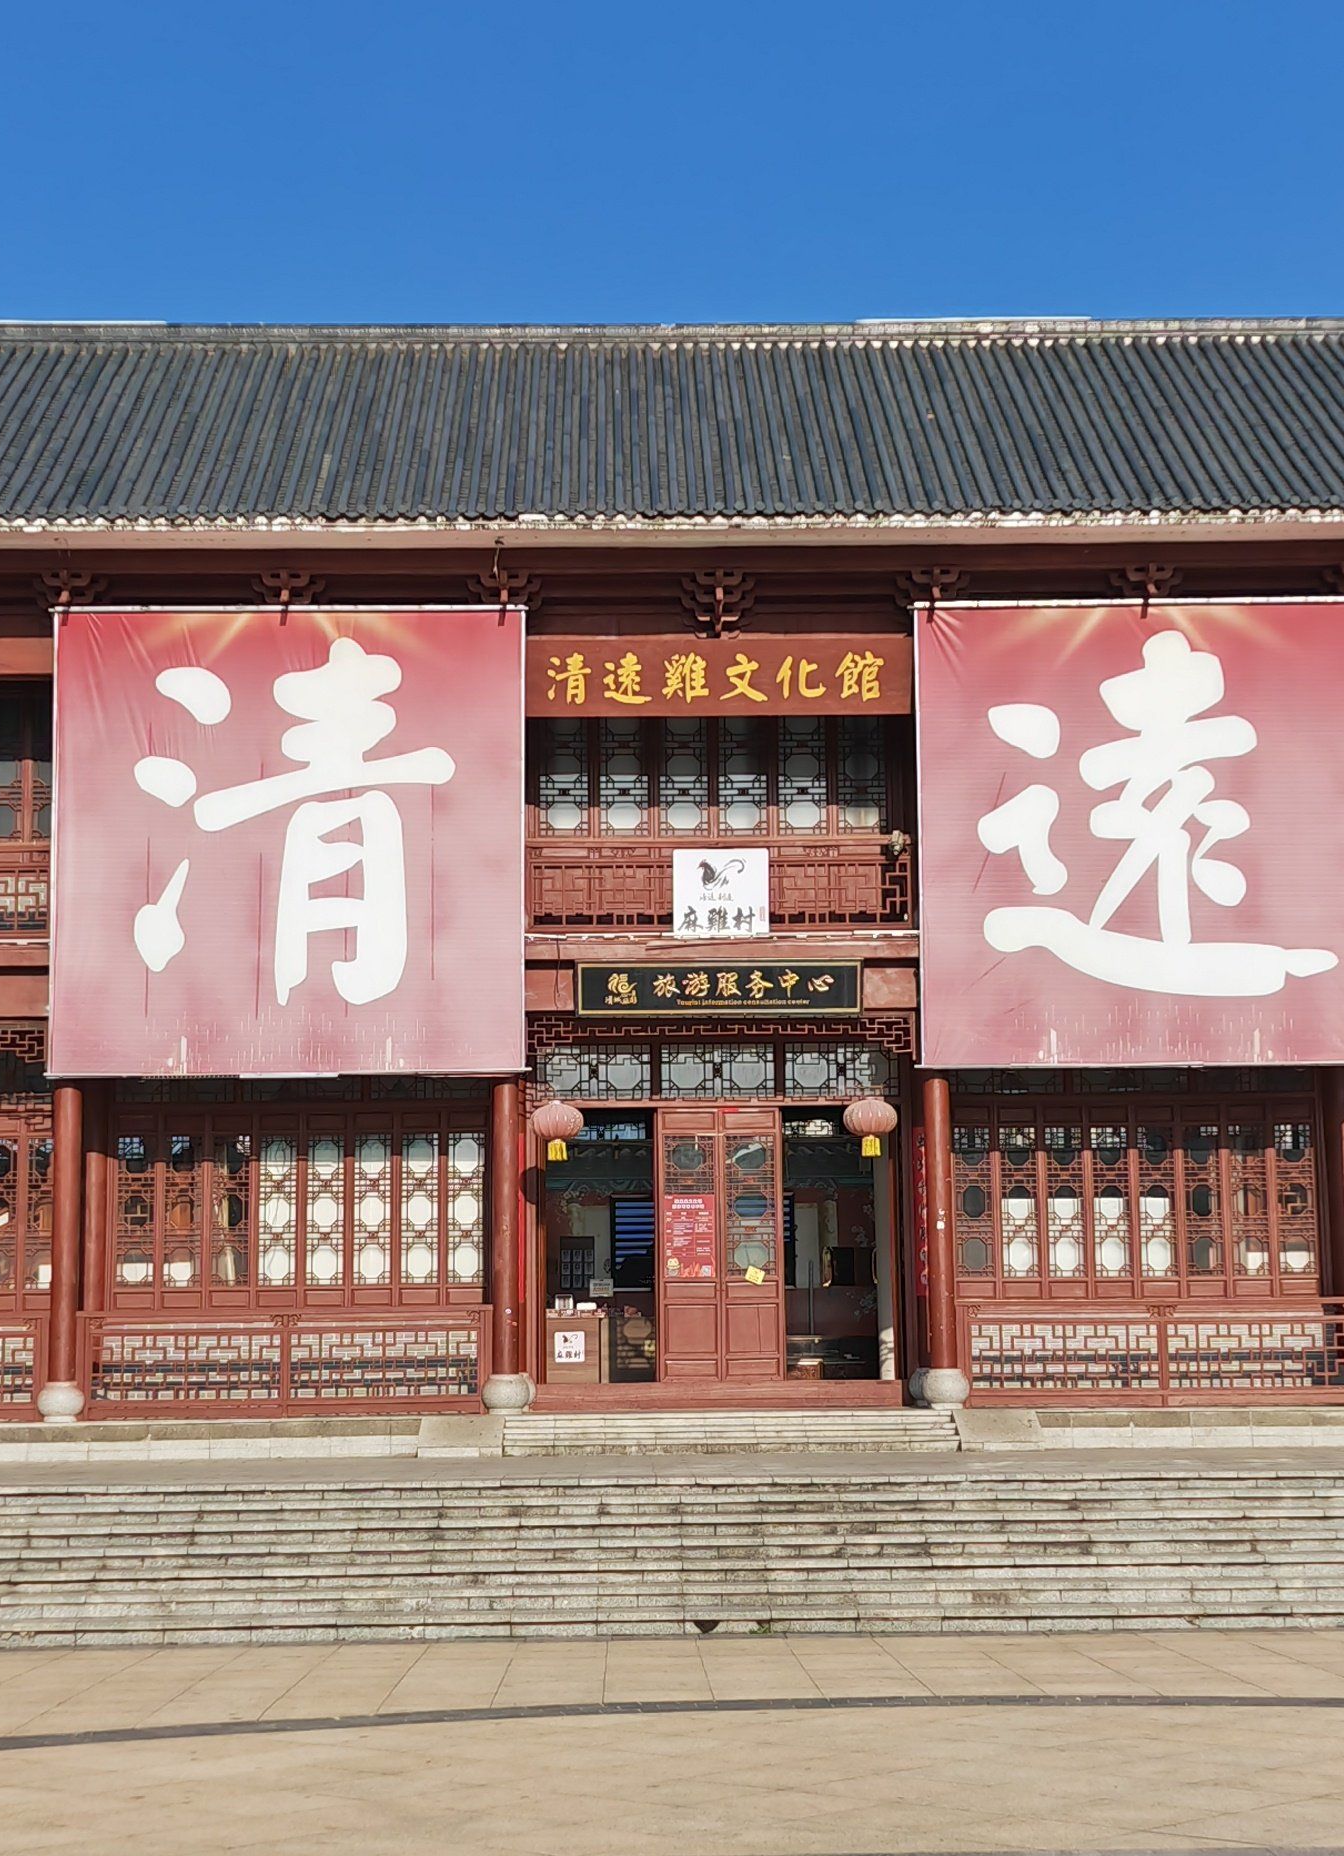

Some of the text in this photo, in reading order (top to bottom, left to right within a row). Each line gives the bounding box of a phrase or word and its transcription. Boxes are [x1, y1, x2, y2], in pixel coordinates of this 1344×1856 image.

[546, 651, 886, 705] 清遠雞文化館
[133, 636, 456, 1006] 清
[652, 968, 835, 999] 旅游服务中心
